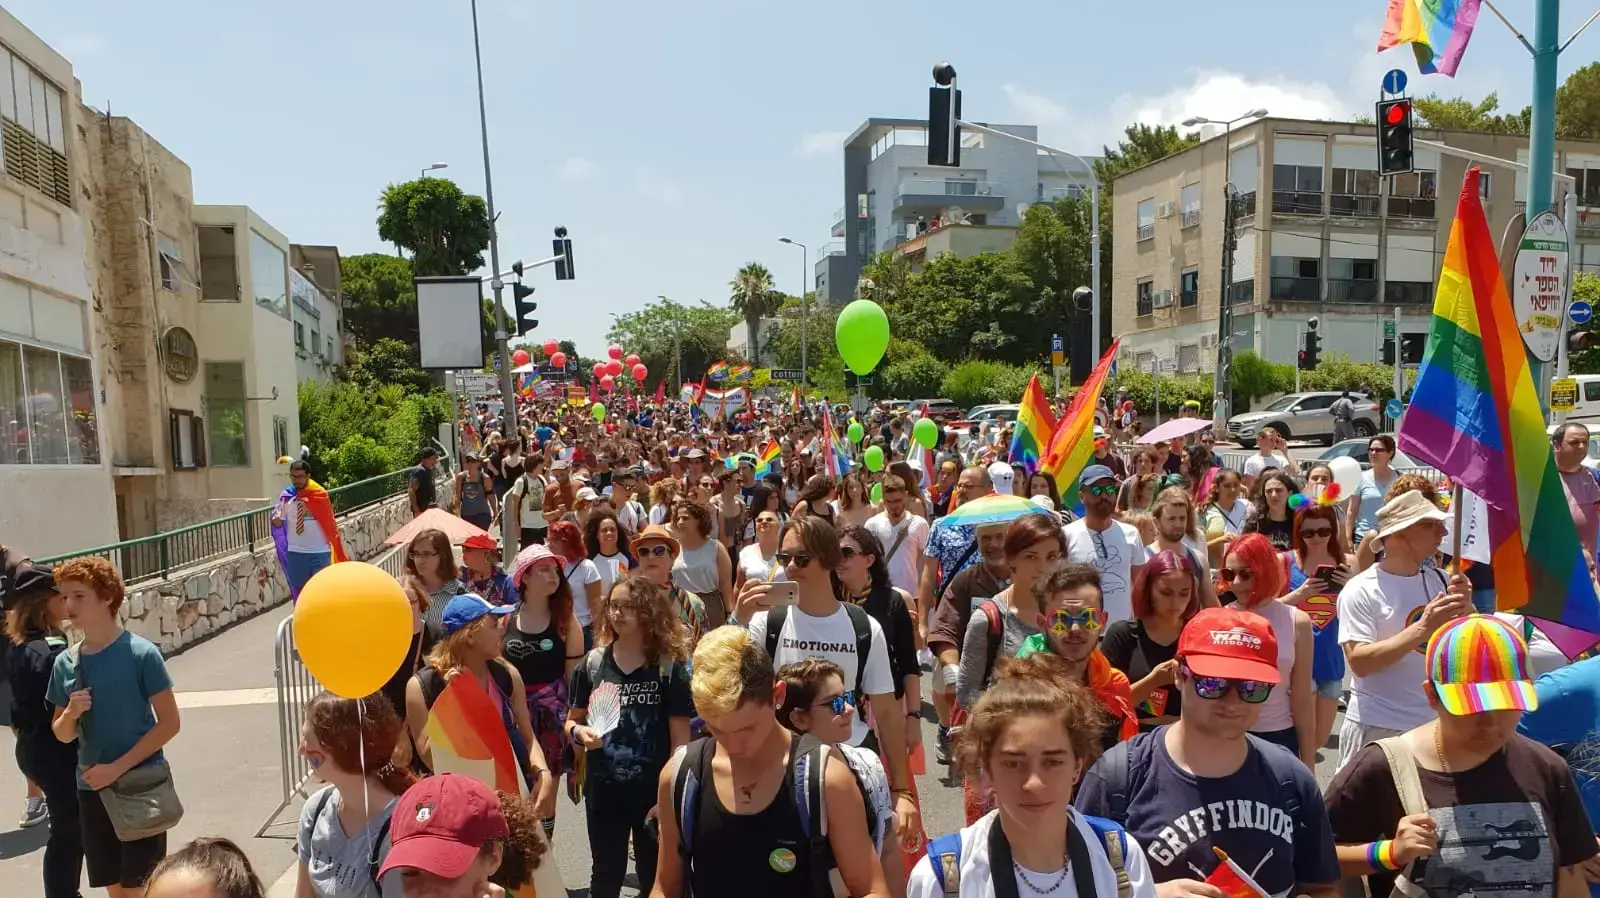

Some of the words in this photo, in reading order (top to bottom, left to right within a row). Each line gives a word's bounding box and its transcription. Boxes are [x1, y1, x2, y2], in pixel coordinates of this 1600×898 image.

[1540, 257, 1557, 273] יריד
[1535, 276, 1559, 292] הספר
[1530, 295, 1560, 311] החיפאי
[773, 371, 801, 379] cotton
[783, 638, 855, 653] EMOTIONAL
[1214, 633, 1261, 644] MANO
[615, 681, 659, 695] ENGED
[621, 693, 661, 706] NFOLD
[1147, 799, 1294, 866] GRYFFINDOR
